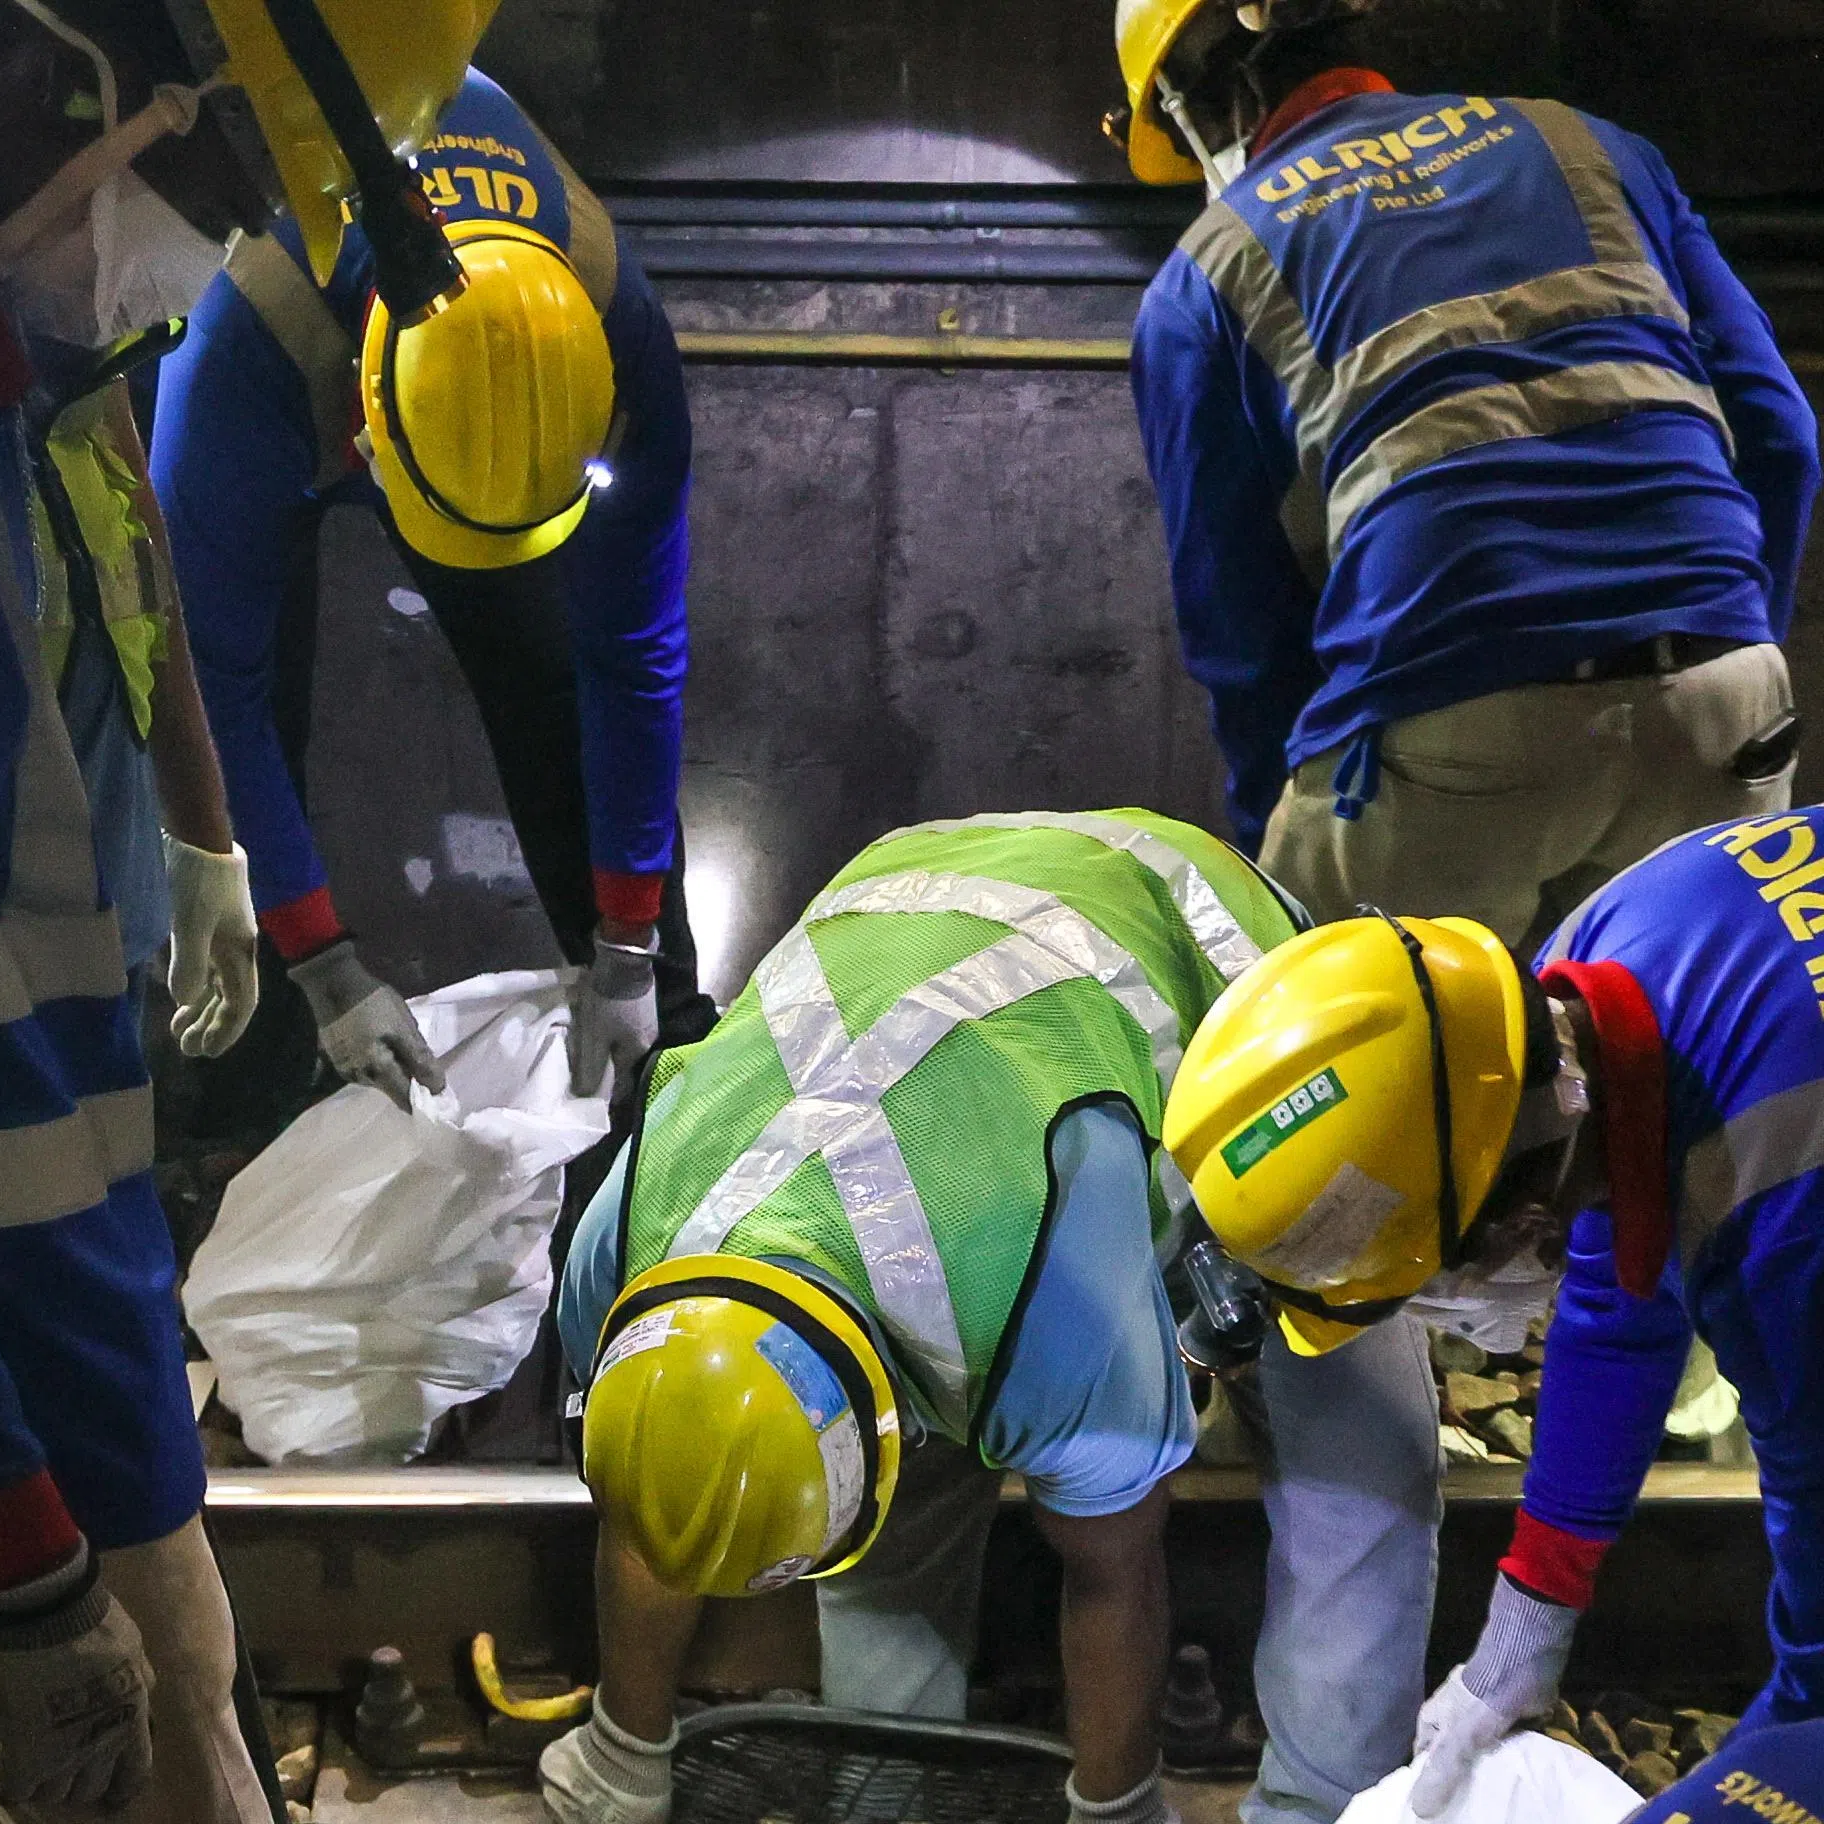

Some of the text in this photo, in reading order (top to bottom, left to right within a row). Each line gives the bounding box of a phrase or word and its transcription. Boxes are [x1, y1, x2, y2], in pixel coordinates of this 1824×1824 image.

[1256, 97, 1497, 202] ULRICH
[1276, 173, 1394, 223] Engineering
[1413, 125, 1514, 180] Railworks
[420, 166, 539, 218] ULR
[1372, 185, 1446, 211] Pte Ltd
